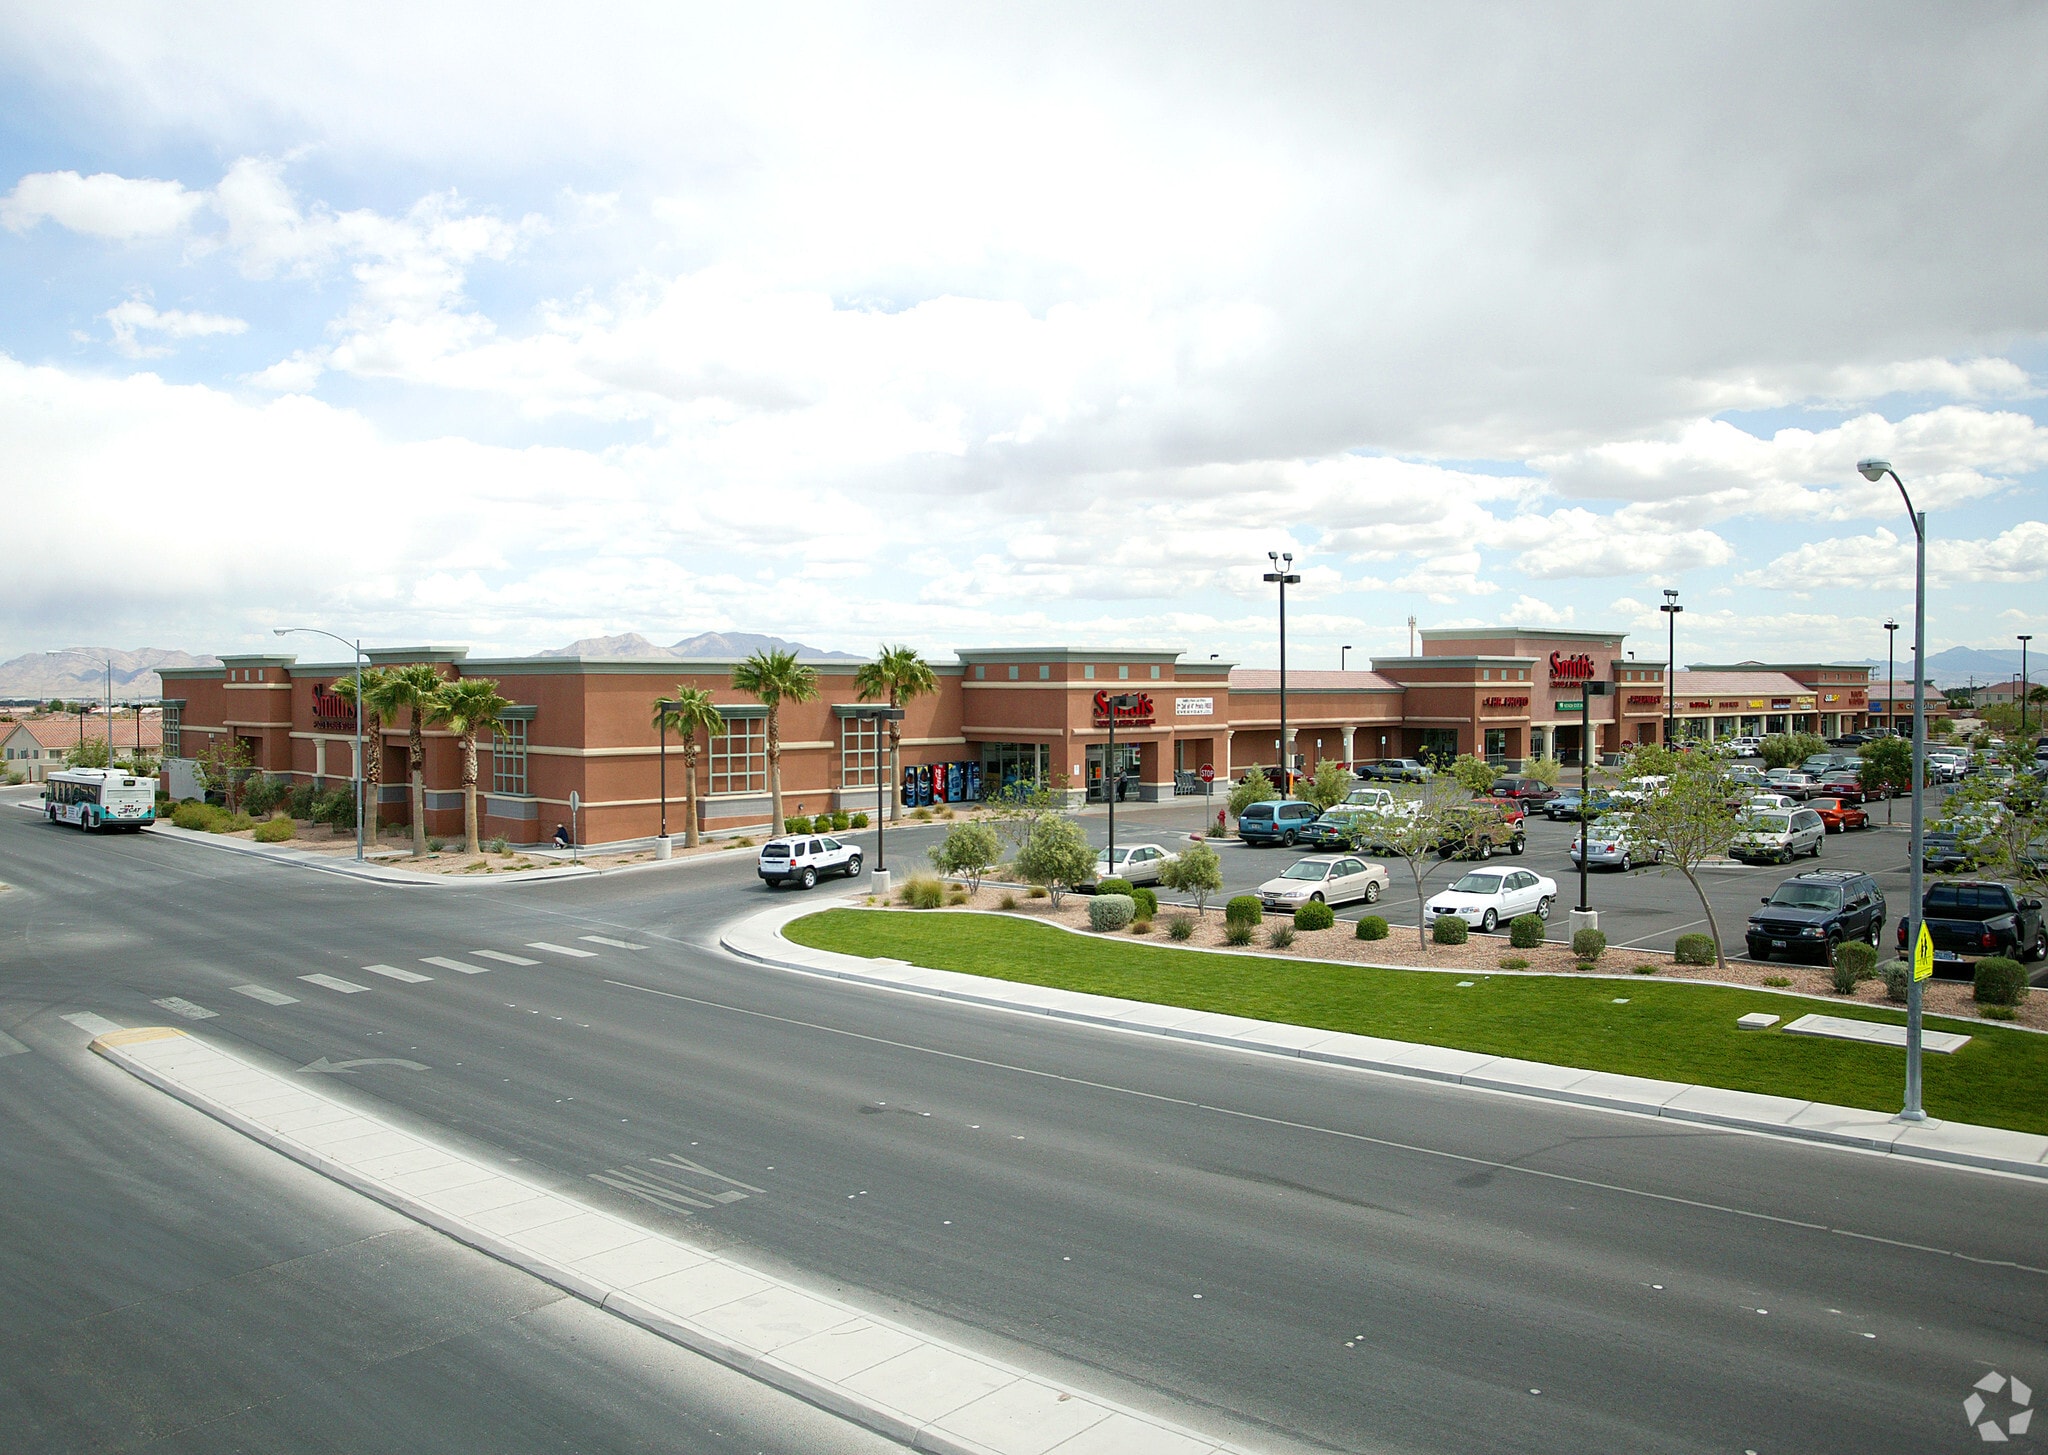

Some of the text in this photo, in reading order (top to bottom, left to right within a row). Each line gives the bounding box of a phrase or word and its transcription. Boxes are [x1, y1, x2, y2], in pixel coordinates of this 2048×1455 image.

[1550, 650, 1594, 678] Smith's
[311, 683, 356, 718] Smiths
[1504, 696, 1529, 706] PHOTO
[1906, 701, 1937, 710] ciular
[1201, 769, 1214, 777] STOP
